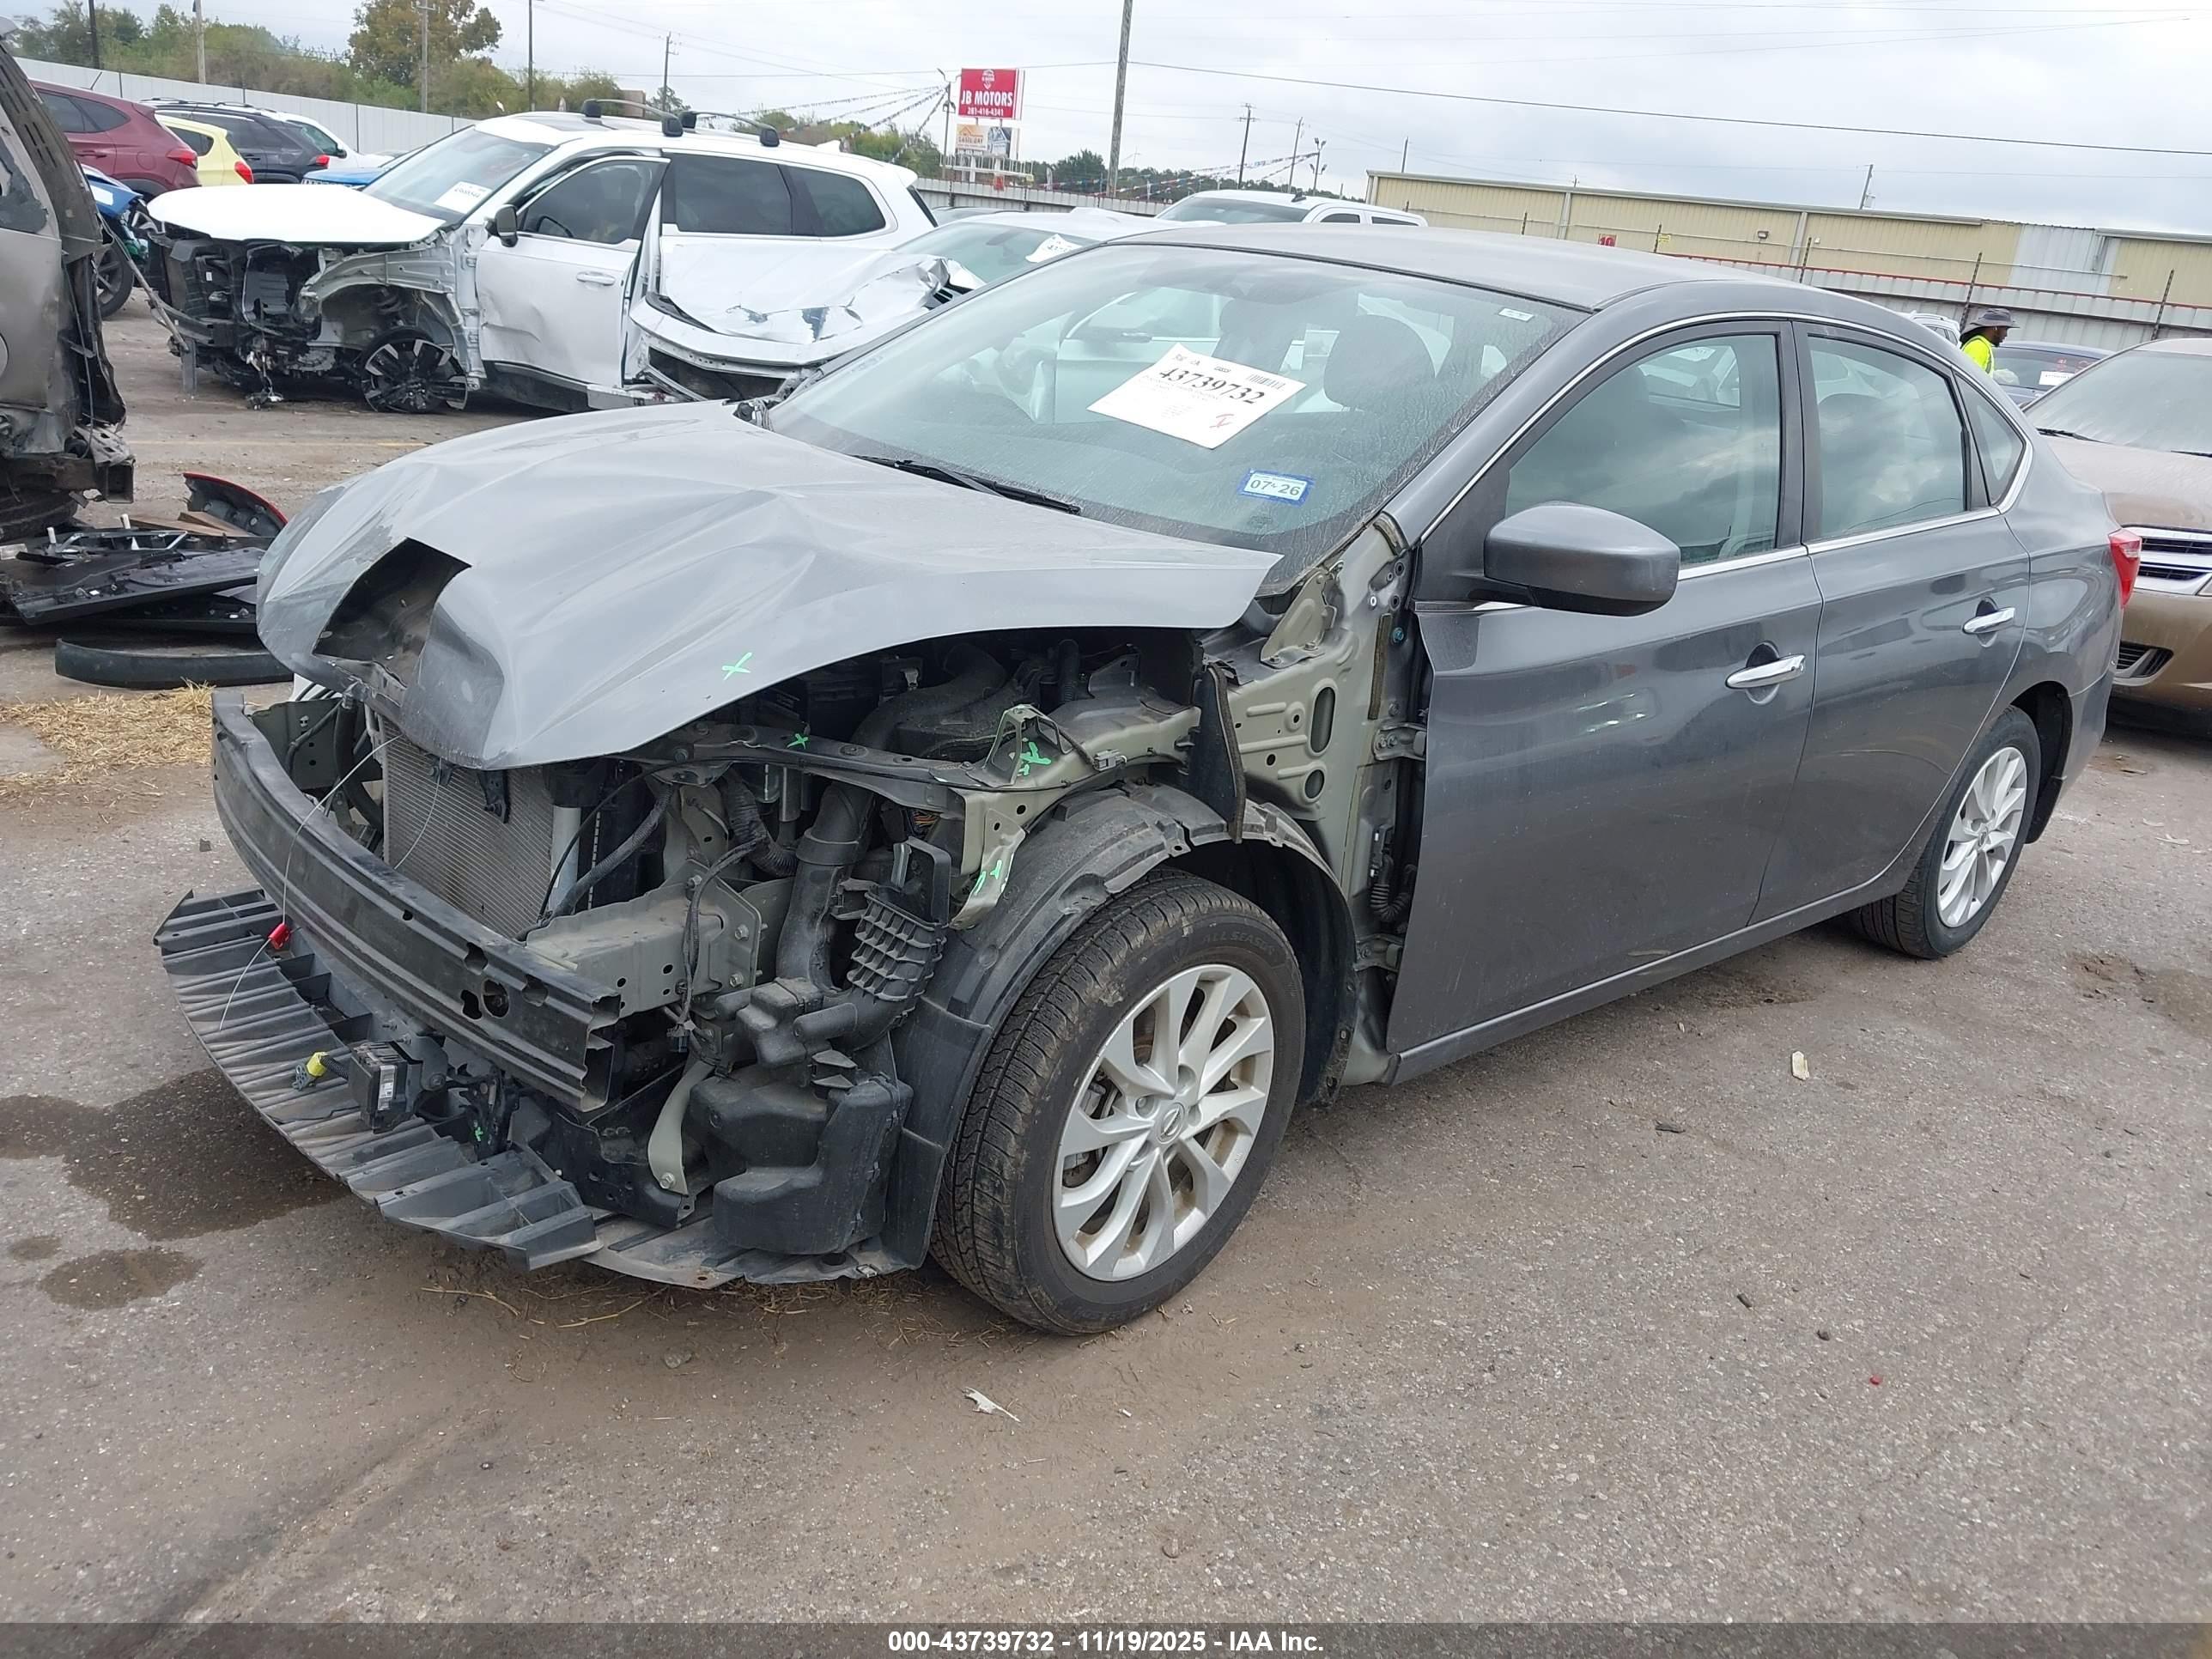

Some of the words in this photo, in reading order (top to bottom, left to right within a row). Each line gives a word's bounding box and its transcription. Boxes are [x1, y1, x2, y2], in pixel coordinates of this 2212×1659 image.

[961, 90, 972, 105] JB
[975, 90, 1013, 106] MOTORS
[1158, 368, 1266, 404] 43739732
[1231, 931, 1276, 955] SEAS
